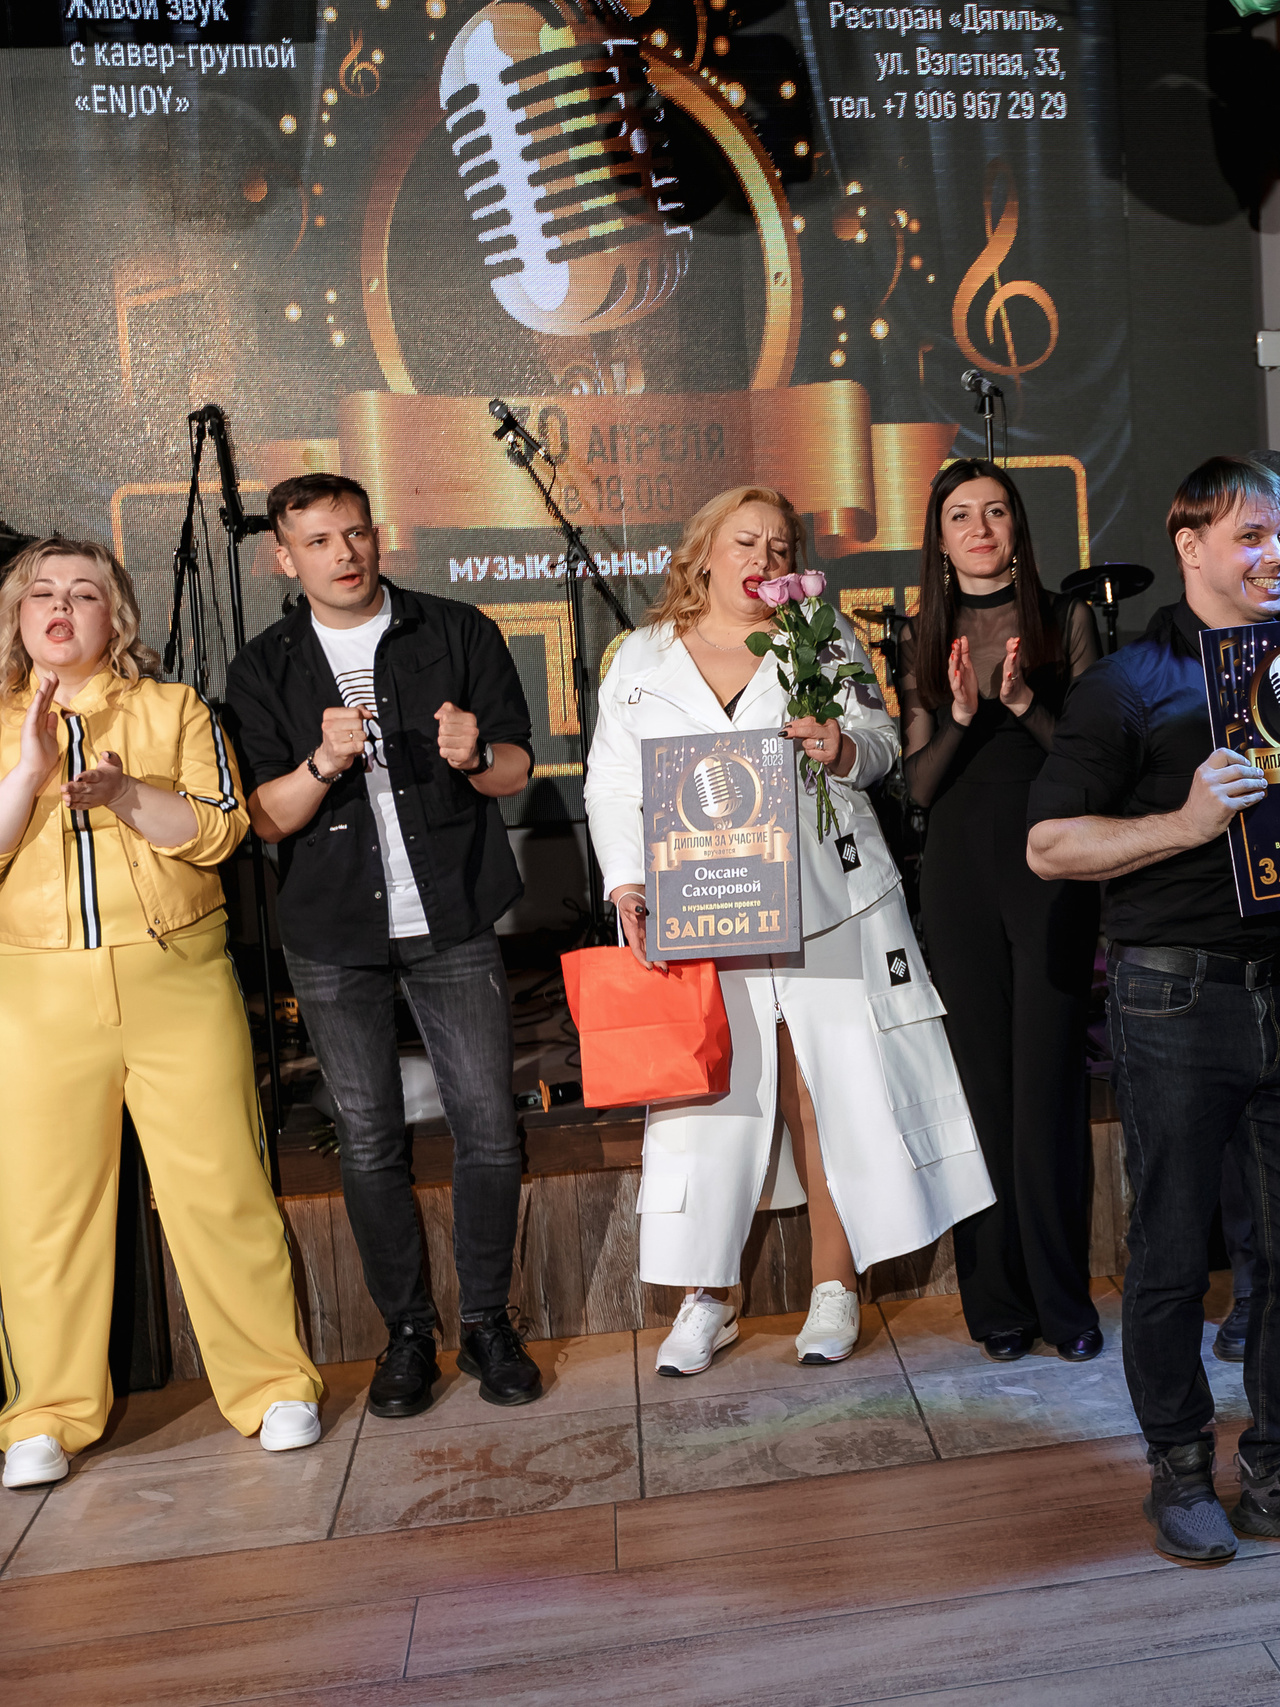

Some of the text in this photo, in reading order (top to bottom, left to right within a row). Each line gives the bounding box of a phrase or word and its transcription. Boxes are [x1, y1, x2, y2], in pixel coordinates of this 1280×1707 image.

[829, 1, 942, 37] Ресторан
[70, 38, 296, 75] с кавер-группой
[874, 46, 1066, 81] ул. Взлетная, 33,
[75, 84, 190, 118] «ENJOY»
[829, 91, 1068, 119] тел. +7 906 967 29 29
[587, 424, 725, 465] АПРЕЛЯ
[591, 474, 675, 512] 18.00
[761, 737, 778, 755] 30
[761, 753, 784, 767] 2023
[674, 831, 769, 851] ДИПЛОМ ЗА УЧАСТИЕ
[703, 848, 736, 857] вручается
[694, 866, 748, 881] Оксане
[682, 880, 761, 899] Сахоровой
[688, 901, 734, 913] музыкальном
[734, 900, 761, 909] проекте
[758, 910, 780, 933] II
